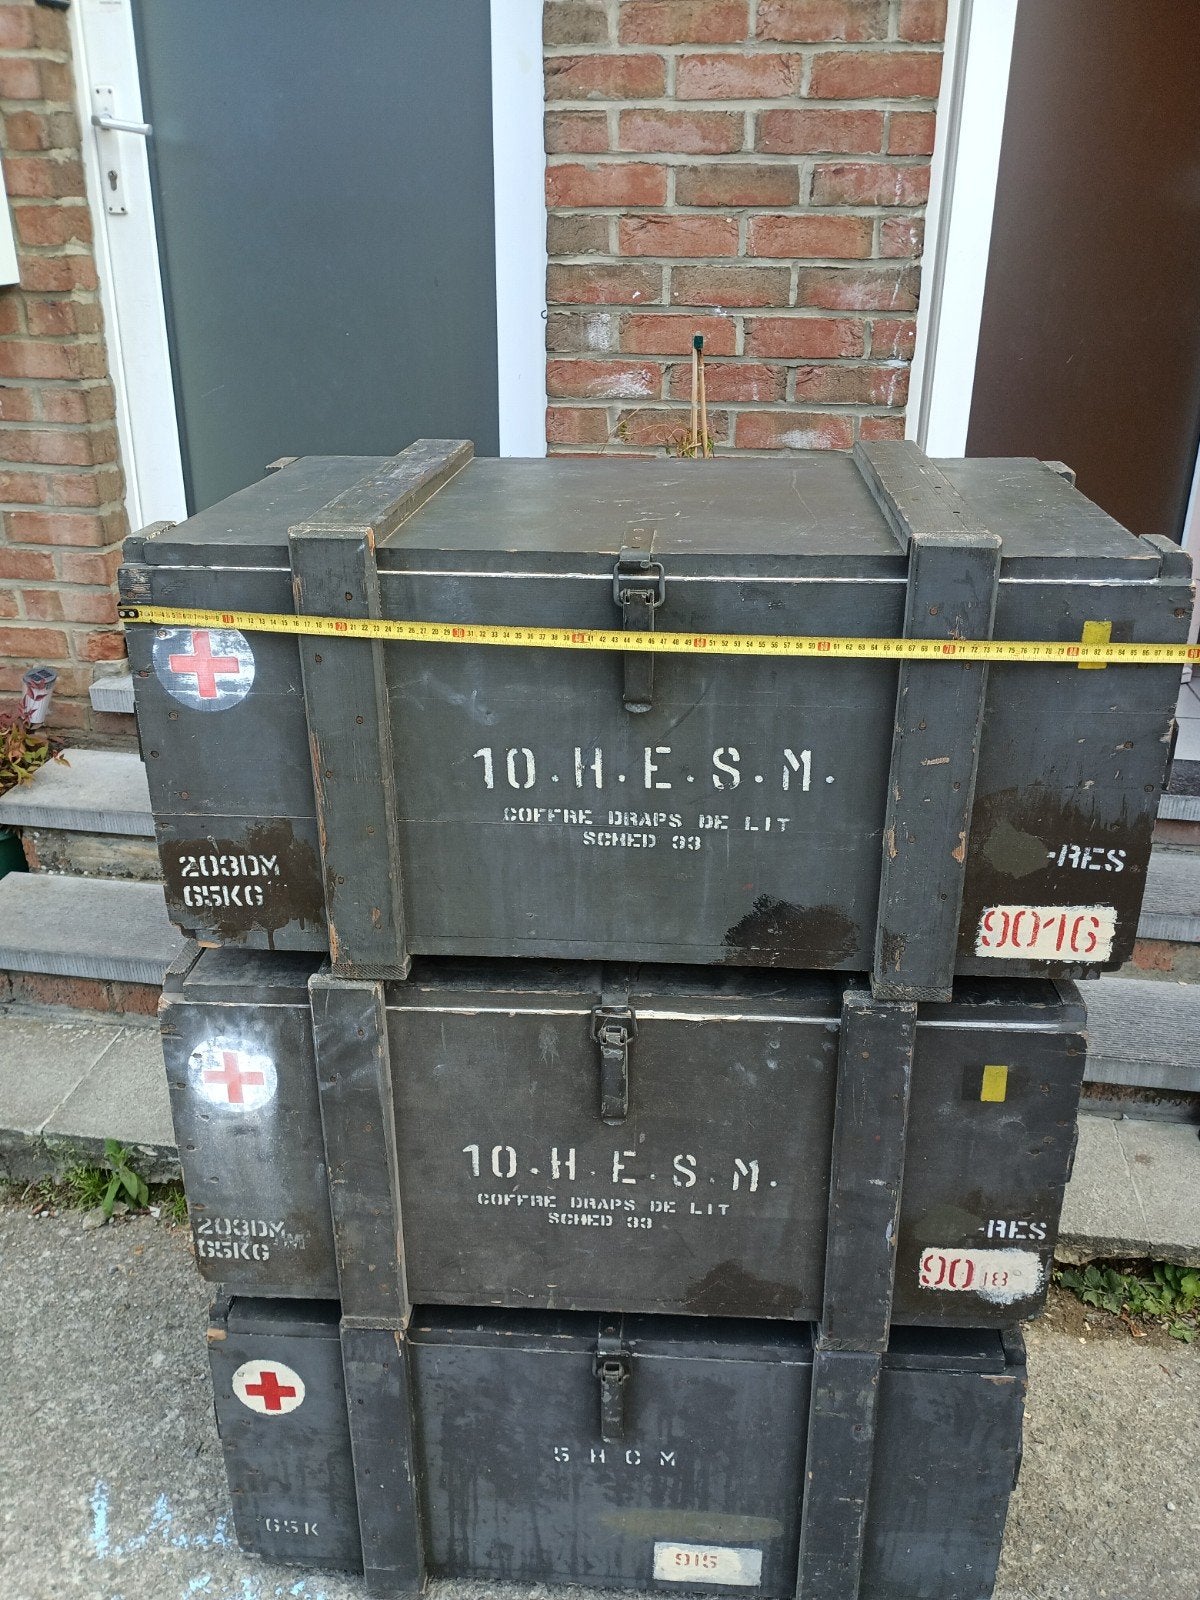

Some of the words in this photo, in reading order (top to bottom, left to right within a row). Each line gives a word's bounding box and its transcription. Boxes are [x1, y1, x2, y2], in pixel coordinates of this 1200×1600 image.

[503, 807, 593, 825] COFFRE
[608, 810, 682, 828] DRAPS
[699, 815, 729, 830] DE
[745, 816, 790, 832] LIT
[583, 831, 656, 848] SCHED
[179, 855, 280, 877] 203DM
[183, 885, 263, 906] 65KG
[982, 911, 1099, 952] 9016
[477, 1193, 556, 1208] COFFRE
[570, 1196, 635, 1211] DRAPS
[651, 1201, 676, 1213] DE
[690, 1203, 729, 1215] LIT
[198, 1218, 285, 1238] 203DM
[549, 1213, 612, 1226] SCHED
[554, 1447, 569, 1462] 5
[591, 1449, 605, 1463] H
[660, 1451, 675, 1466] M
